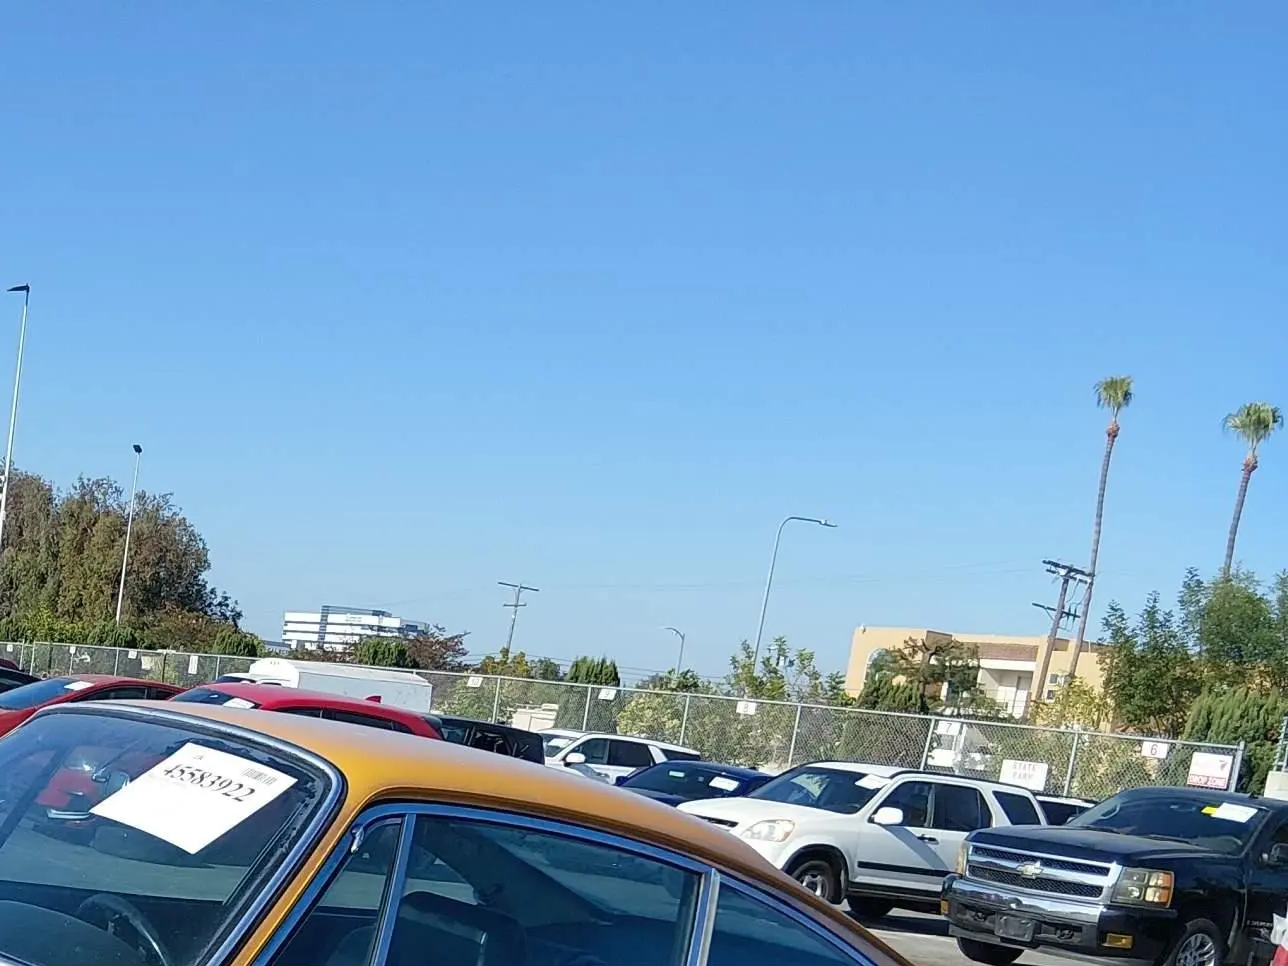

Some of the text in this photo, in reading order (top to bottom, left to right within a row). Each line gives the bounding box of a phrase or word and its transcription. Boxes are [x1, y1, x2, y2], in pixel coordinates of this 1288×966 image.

[945, 722, 953, 733] 7
[1150, 743, 1158, 756] 6
[163, 763, 255, 802] 45583922
